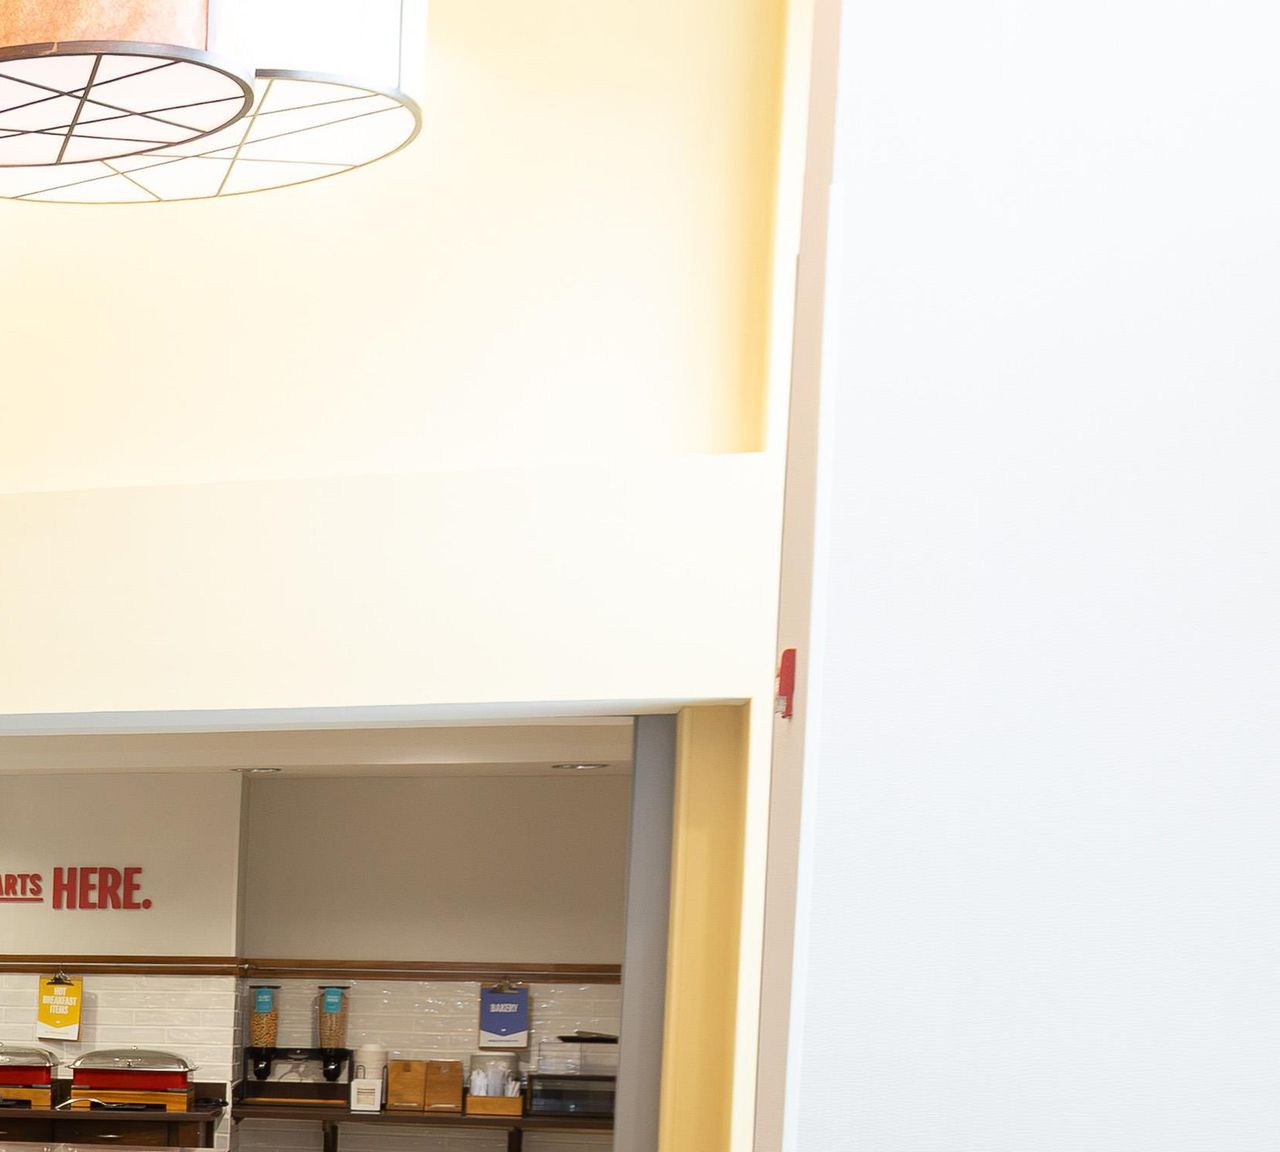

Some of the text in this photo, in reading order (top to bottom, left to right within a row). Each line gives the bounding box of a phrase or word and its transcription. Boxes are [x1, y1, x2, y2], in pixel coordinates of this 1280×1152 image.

[52, 867, 152, 910] HERE.
[54, 987, 67, 996] HOT
[43, 995, 77, 1006] BREAKFAST
[49, 1005, 69, 1014] ITEMS
[490, 1003, 519, 1013] BAKERY
